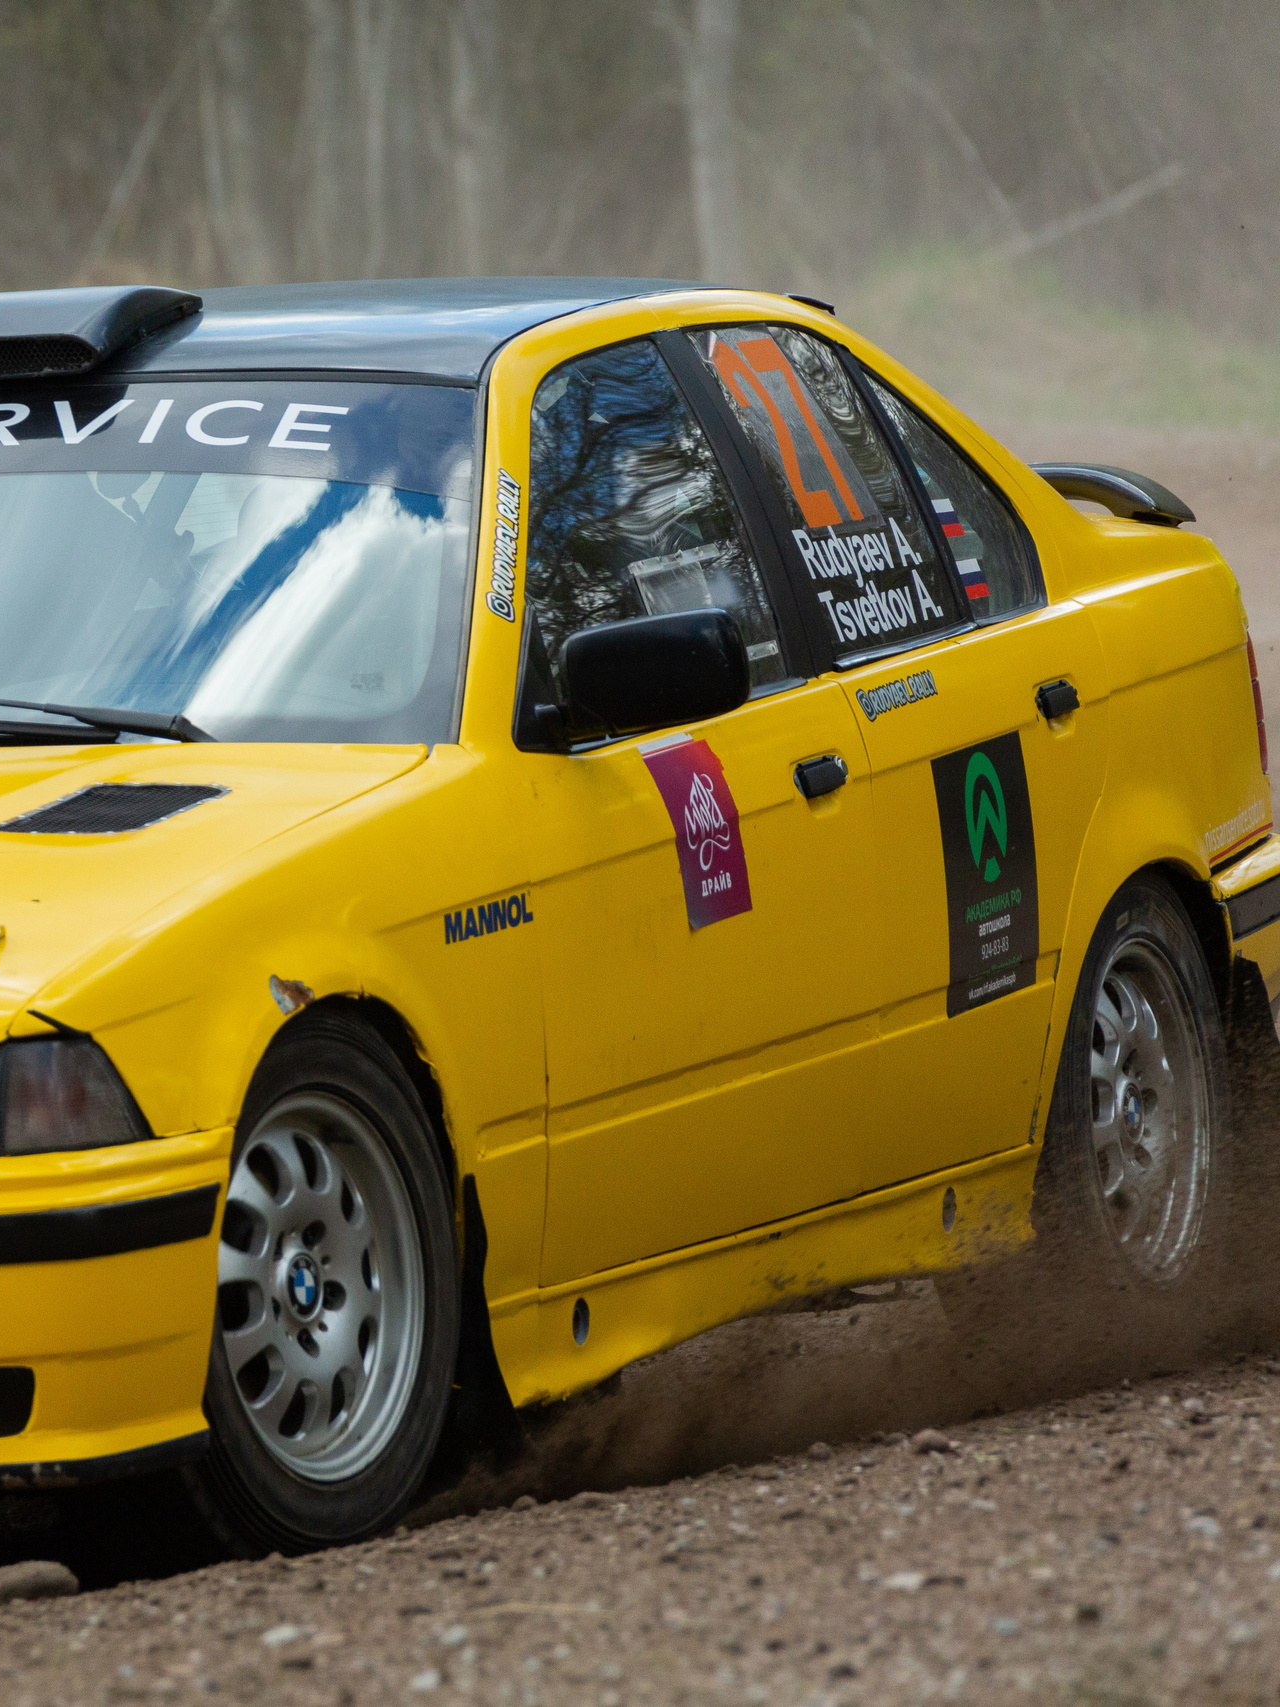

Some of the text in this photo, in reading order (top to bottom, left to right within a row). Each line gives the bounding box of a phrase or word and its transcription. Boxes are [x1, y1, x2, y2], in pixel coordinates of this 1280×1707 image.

[712, 338, 864, 528] 27
[792, 517, 923, 587] Rudyaev A.
[818, 569, 943, 643] Tsvetkov A.
[701, 870, 732, 897] ДРАЙВ
[444, 893, 533, 945] MANNOL
[966, 888, 1021, 923] АКАДЕМИКА РФ
[979, 914, 1010, 937] автошкола
[982, 936, 1008, 959] 924-83-83
